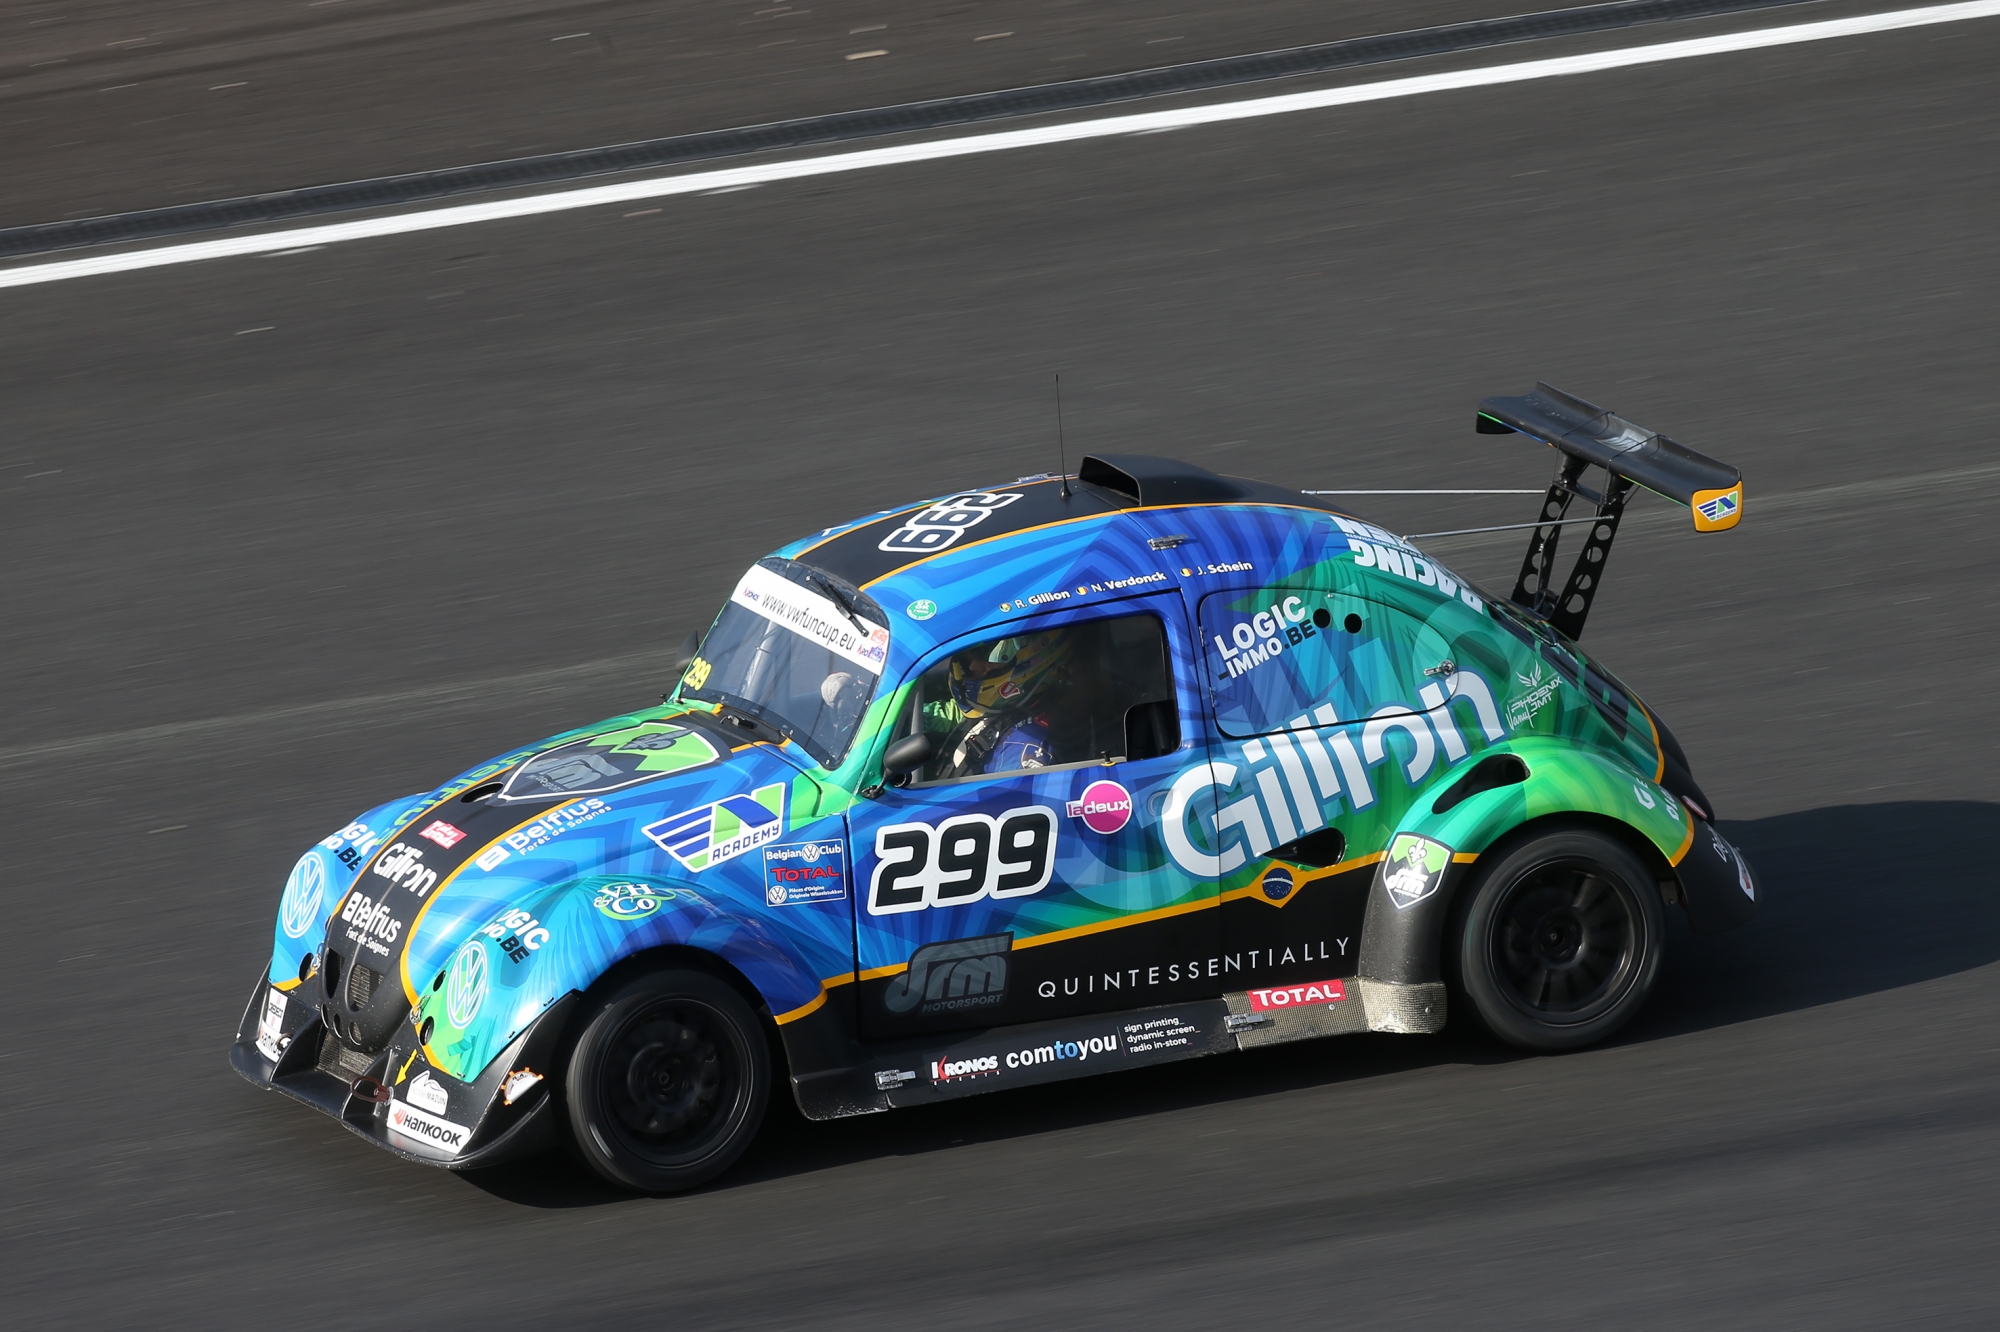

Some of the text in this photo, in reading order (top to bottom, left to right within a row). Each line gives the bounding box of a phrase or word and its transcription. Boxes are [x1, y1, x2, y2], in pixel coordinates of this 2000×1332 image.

[880, 493, 1023, 551] 299
[1013, 560, 1254, 610] R. Gillion N. Verdonck J. Schein
[1347, 538, 1484, 615] RACING
[762, 593, 857, 651] www.vwfuncup.eu
[1214, 596, 1306, 661] LOGIC
[683, 656, 713, 690] 299
[1511, 676, 1563, 713] PHOENIX
[1162, 672, 1506, 877] Gillion
[504, 797, 605, 850] Belfius
[518, 805, 613, 857] Forêt de Soignes
[712, 823, 780, 861] ACADEMY
[766, 848, 802, 861] Belgian
[819, 844, 842, 855] Club
[871, 808, 1055, 912] 299
[596, 883, 657, 899] VH
[771, 866, 840, 882] TOTAL
[352, 896, 402, 943] Belfius
[611, 896, 656, 914] Co
[1038, 936, 1350, 999] QUINTESSENTIALLY
[921, 993, 1004, 1013] MOTORSPORT
[1252, 984, 1342, 1008] TOTAL
[1123, 1023, 1143, 1034] sign
[1126, 1029, 1165, 1043] dynamic
[1005, 1034, 1118, 1068] comtoyou
[1129, 1043, 1153, 1054] radio
[931, 1055, 999, 1080] KRONOS
